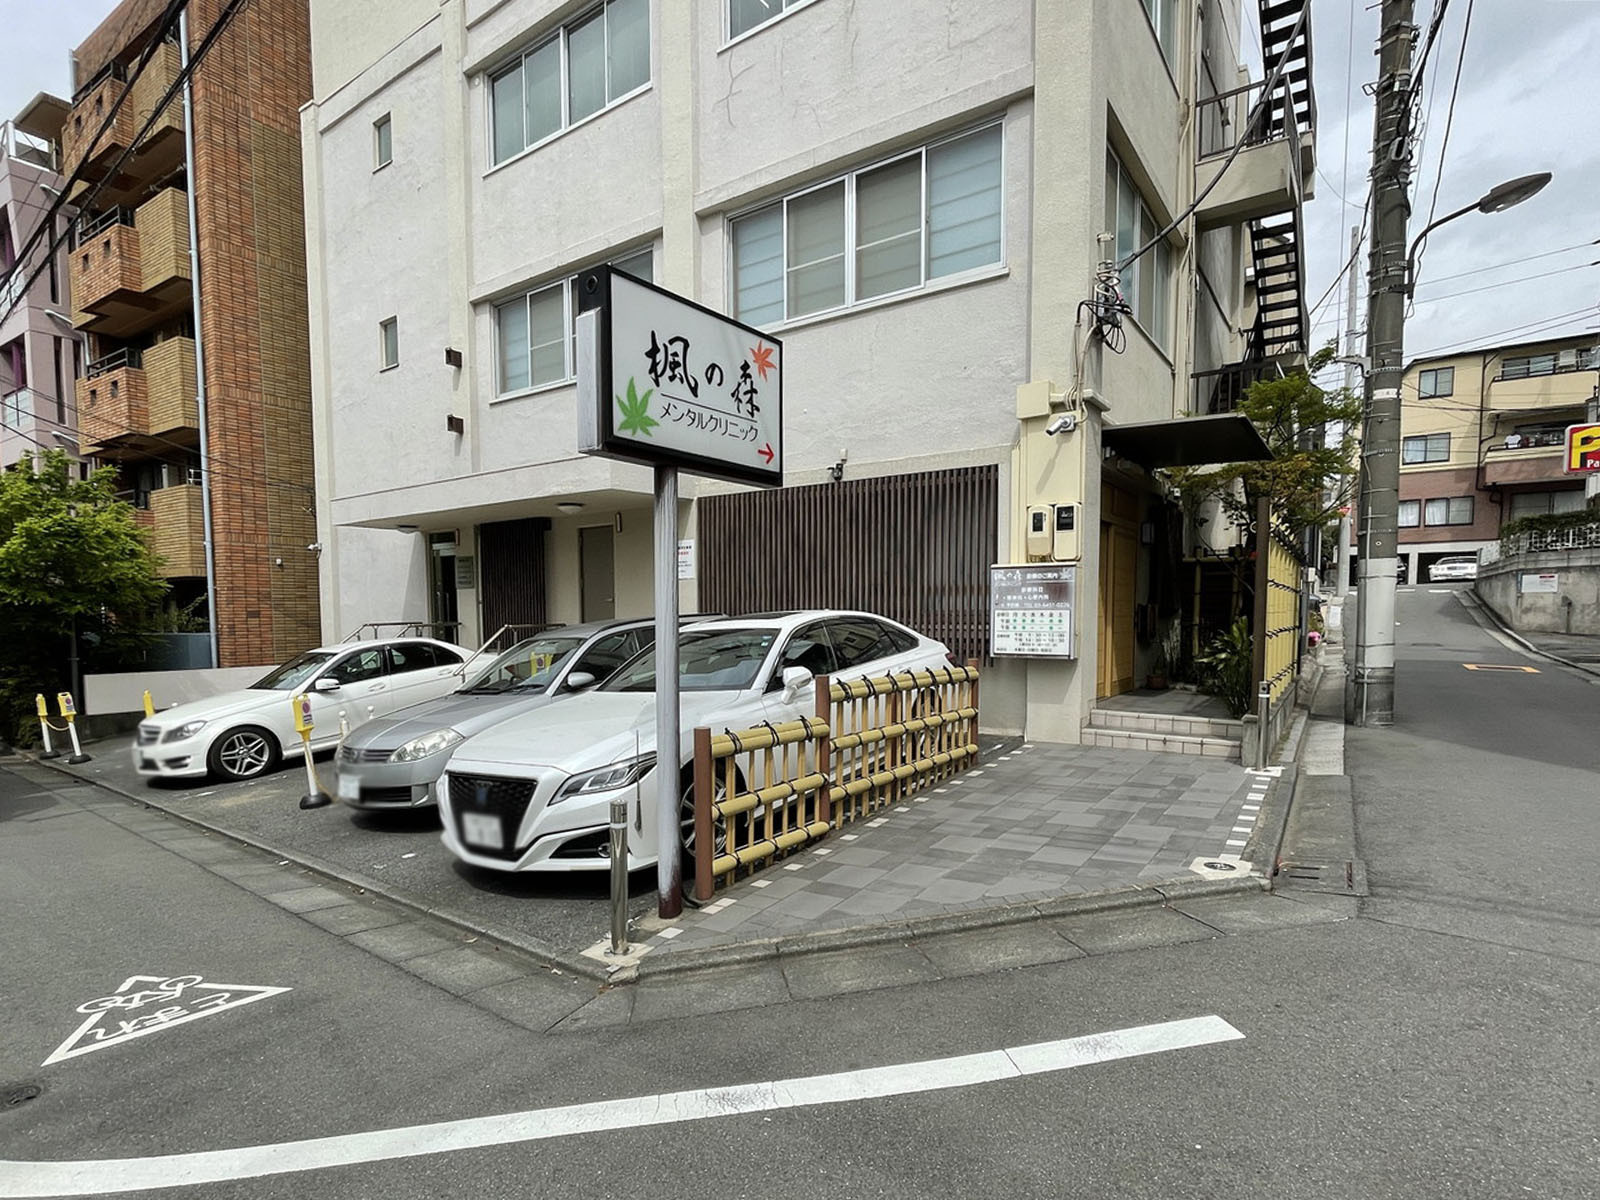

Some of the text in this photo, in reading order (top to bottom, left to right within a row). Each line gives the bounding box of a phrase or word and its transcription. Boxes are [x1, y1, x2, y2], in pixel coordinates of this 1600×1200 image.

[644, 330, 761, 417] 楓の森
[660, 402, 759, 442] メンタルクリニック
[87, 993, 231, 1040] とまれ
